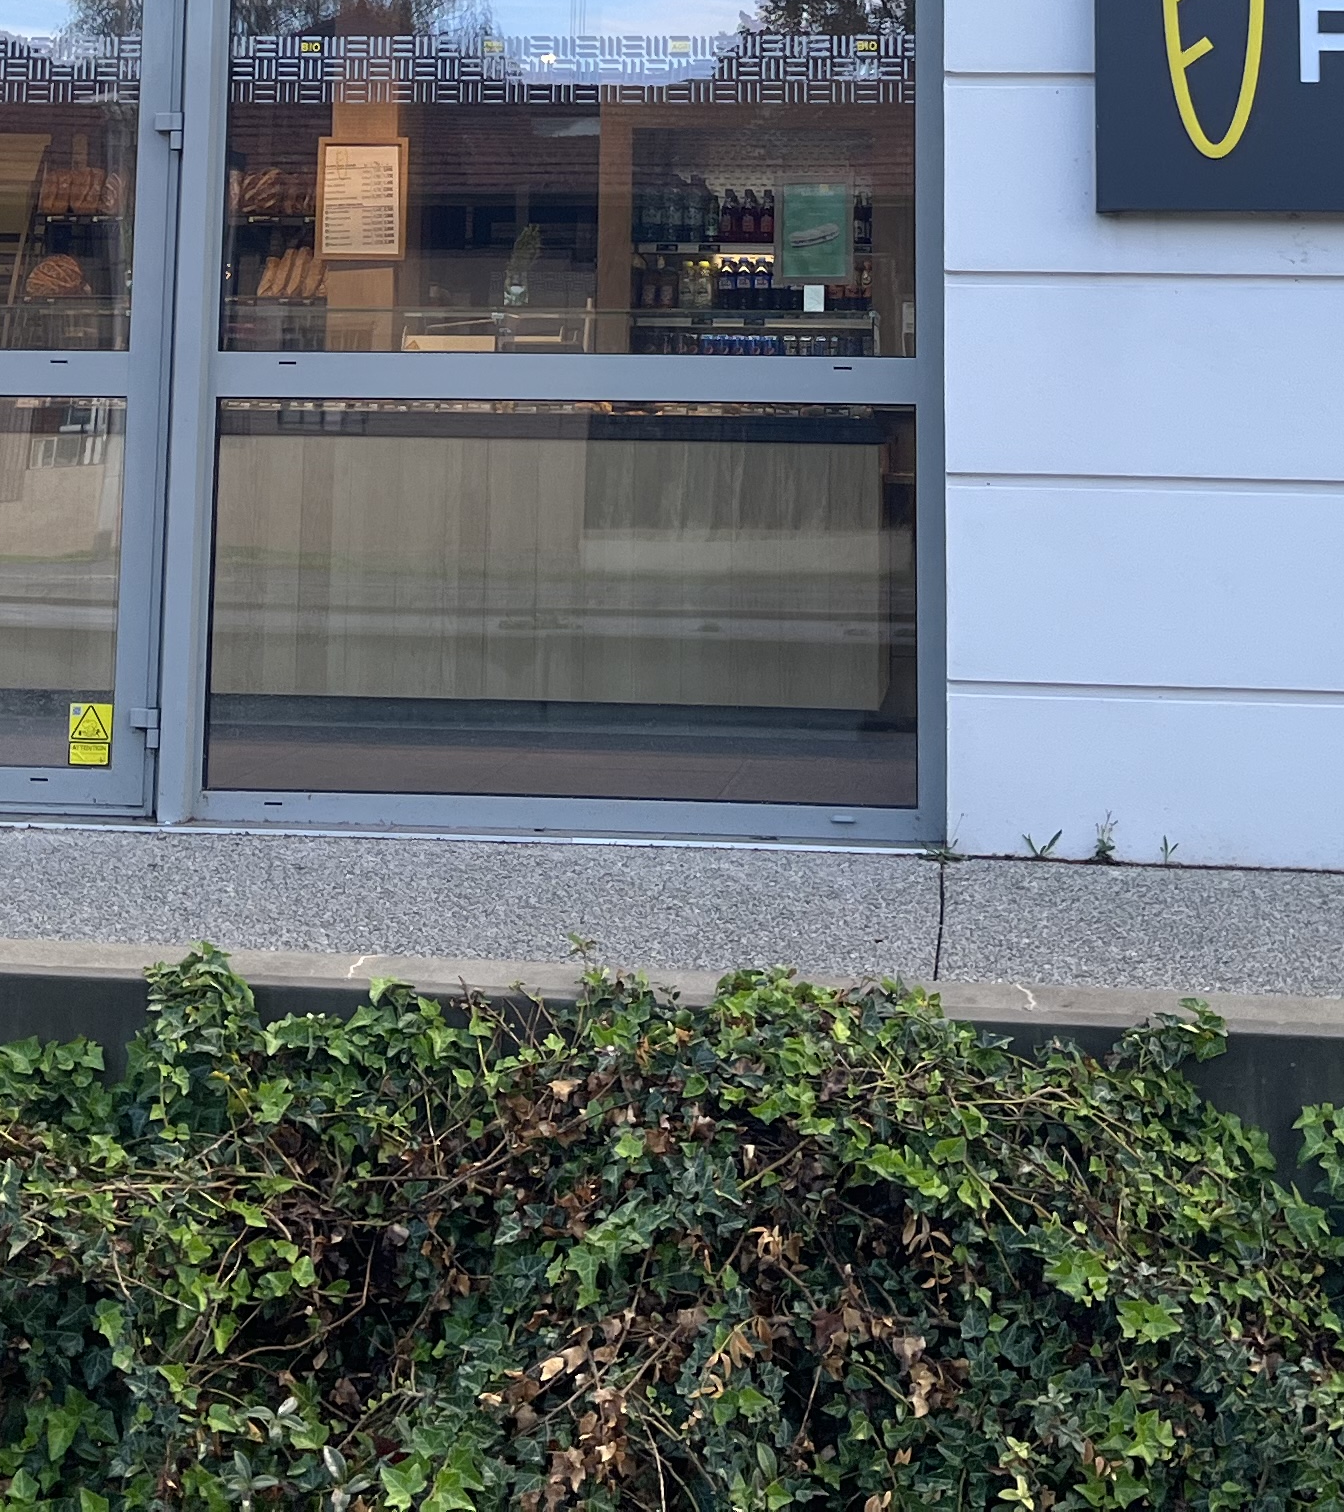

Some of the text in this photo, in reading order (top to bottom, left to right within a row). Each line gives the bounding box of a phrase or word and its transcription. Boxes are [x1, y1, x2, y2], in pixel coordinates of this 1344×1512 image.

[301, 42, 321, 52] BIO
[856, 40, 877, 51] BIO
[72, 744, 107, 752] ATTENTION
